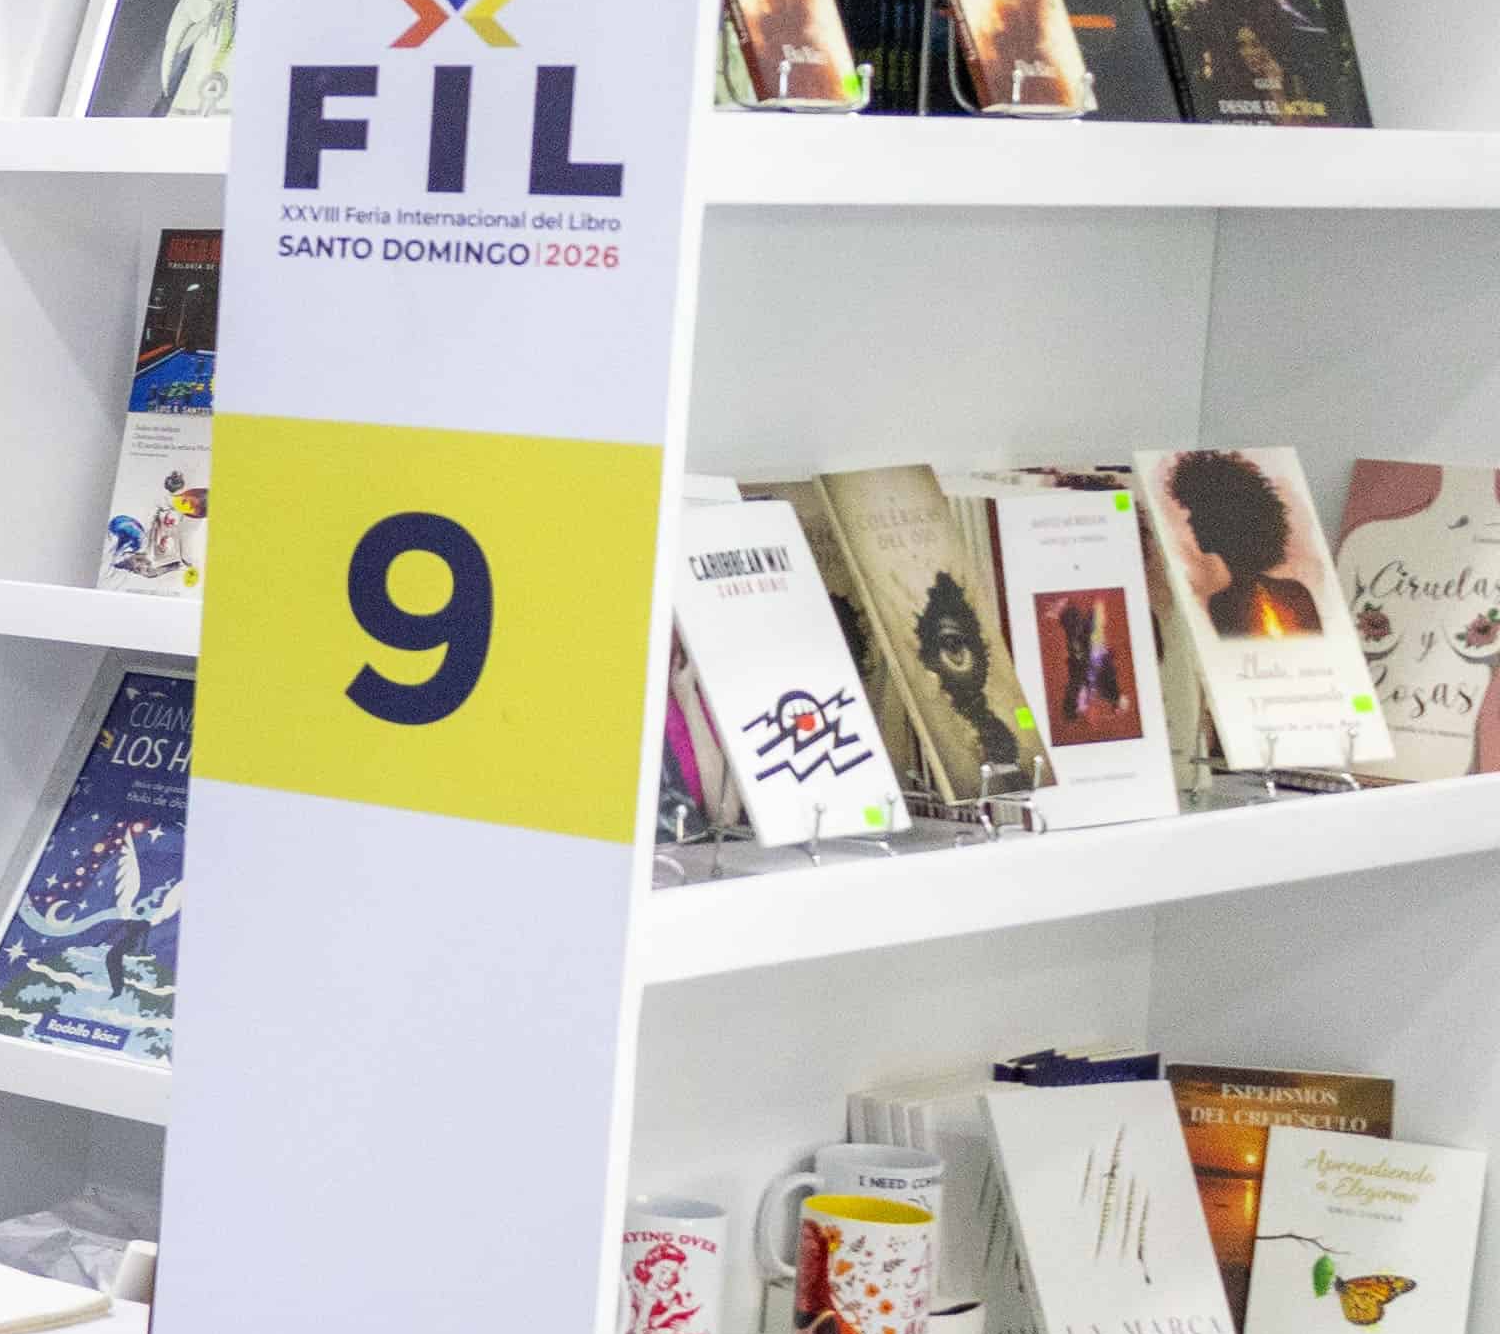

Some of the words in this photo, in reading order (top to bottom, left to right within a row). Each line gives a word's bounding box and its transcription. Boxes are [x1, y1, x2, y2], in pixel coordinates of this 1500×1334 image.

[282, 64, 625, 198] FIL
[280, 203, 341, 224] XXVIII
[344, 205, 392, 225] Feria
[396, 207, 527, 230] Internacional
[531, 210, 563, 231] del
[569, 211, 622, 233] Libro
[277, 234, 373, 262] SANTO
[381, 237, 531, 267] DOMINGO
[543, 243, 620, 269] 2026
[344, 511, 494, 726] 9
[1418, 629, 1438, 662] y
[130, 701, 195, 732] CUAN
[111, 734, 168, 769] LOS
[1189, 1104, 1229, 1126] DEL
[869, 1176, 906, 1190] NEED
